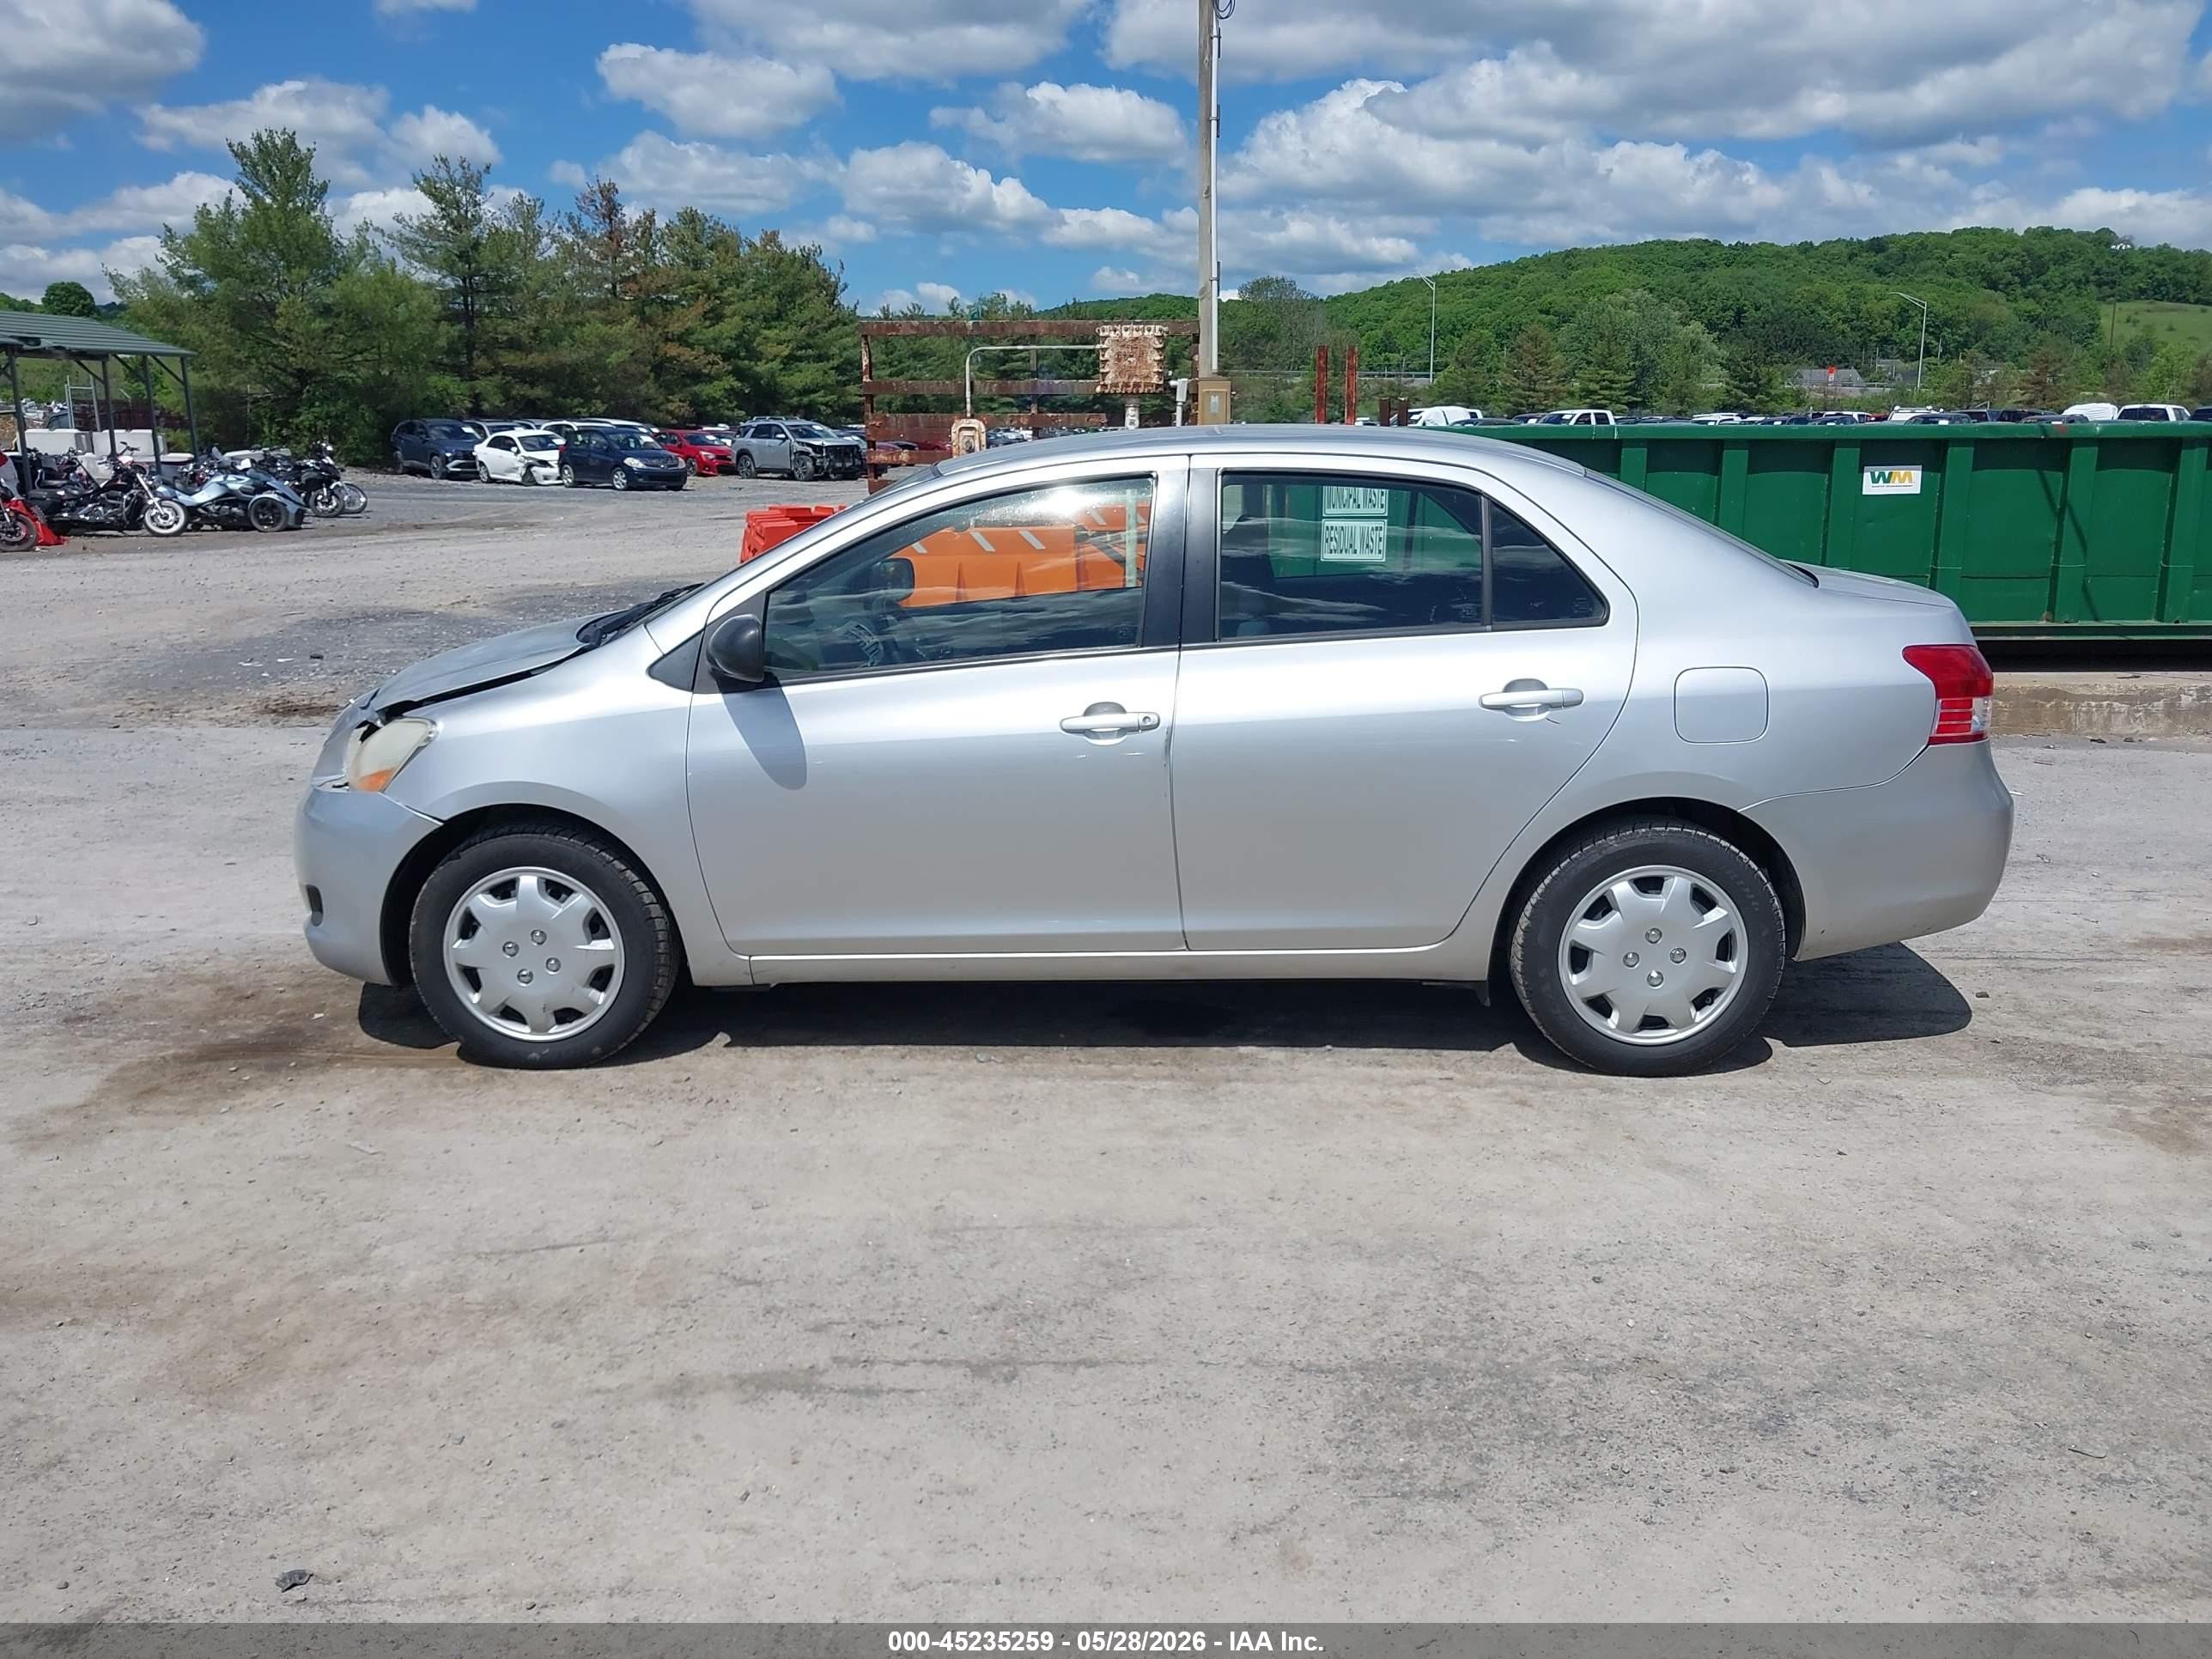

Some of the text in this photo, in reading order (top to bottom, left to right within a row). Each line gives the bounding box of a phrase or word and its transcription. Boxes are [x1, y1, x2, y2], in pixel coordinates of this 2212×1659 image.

[1869, 470, 1913, 484] WM
[1326, 487, 1385, 509] MUNICIPAL WASTE
[1324, 526, 1383, 555] RESIDUAL WASTE
